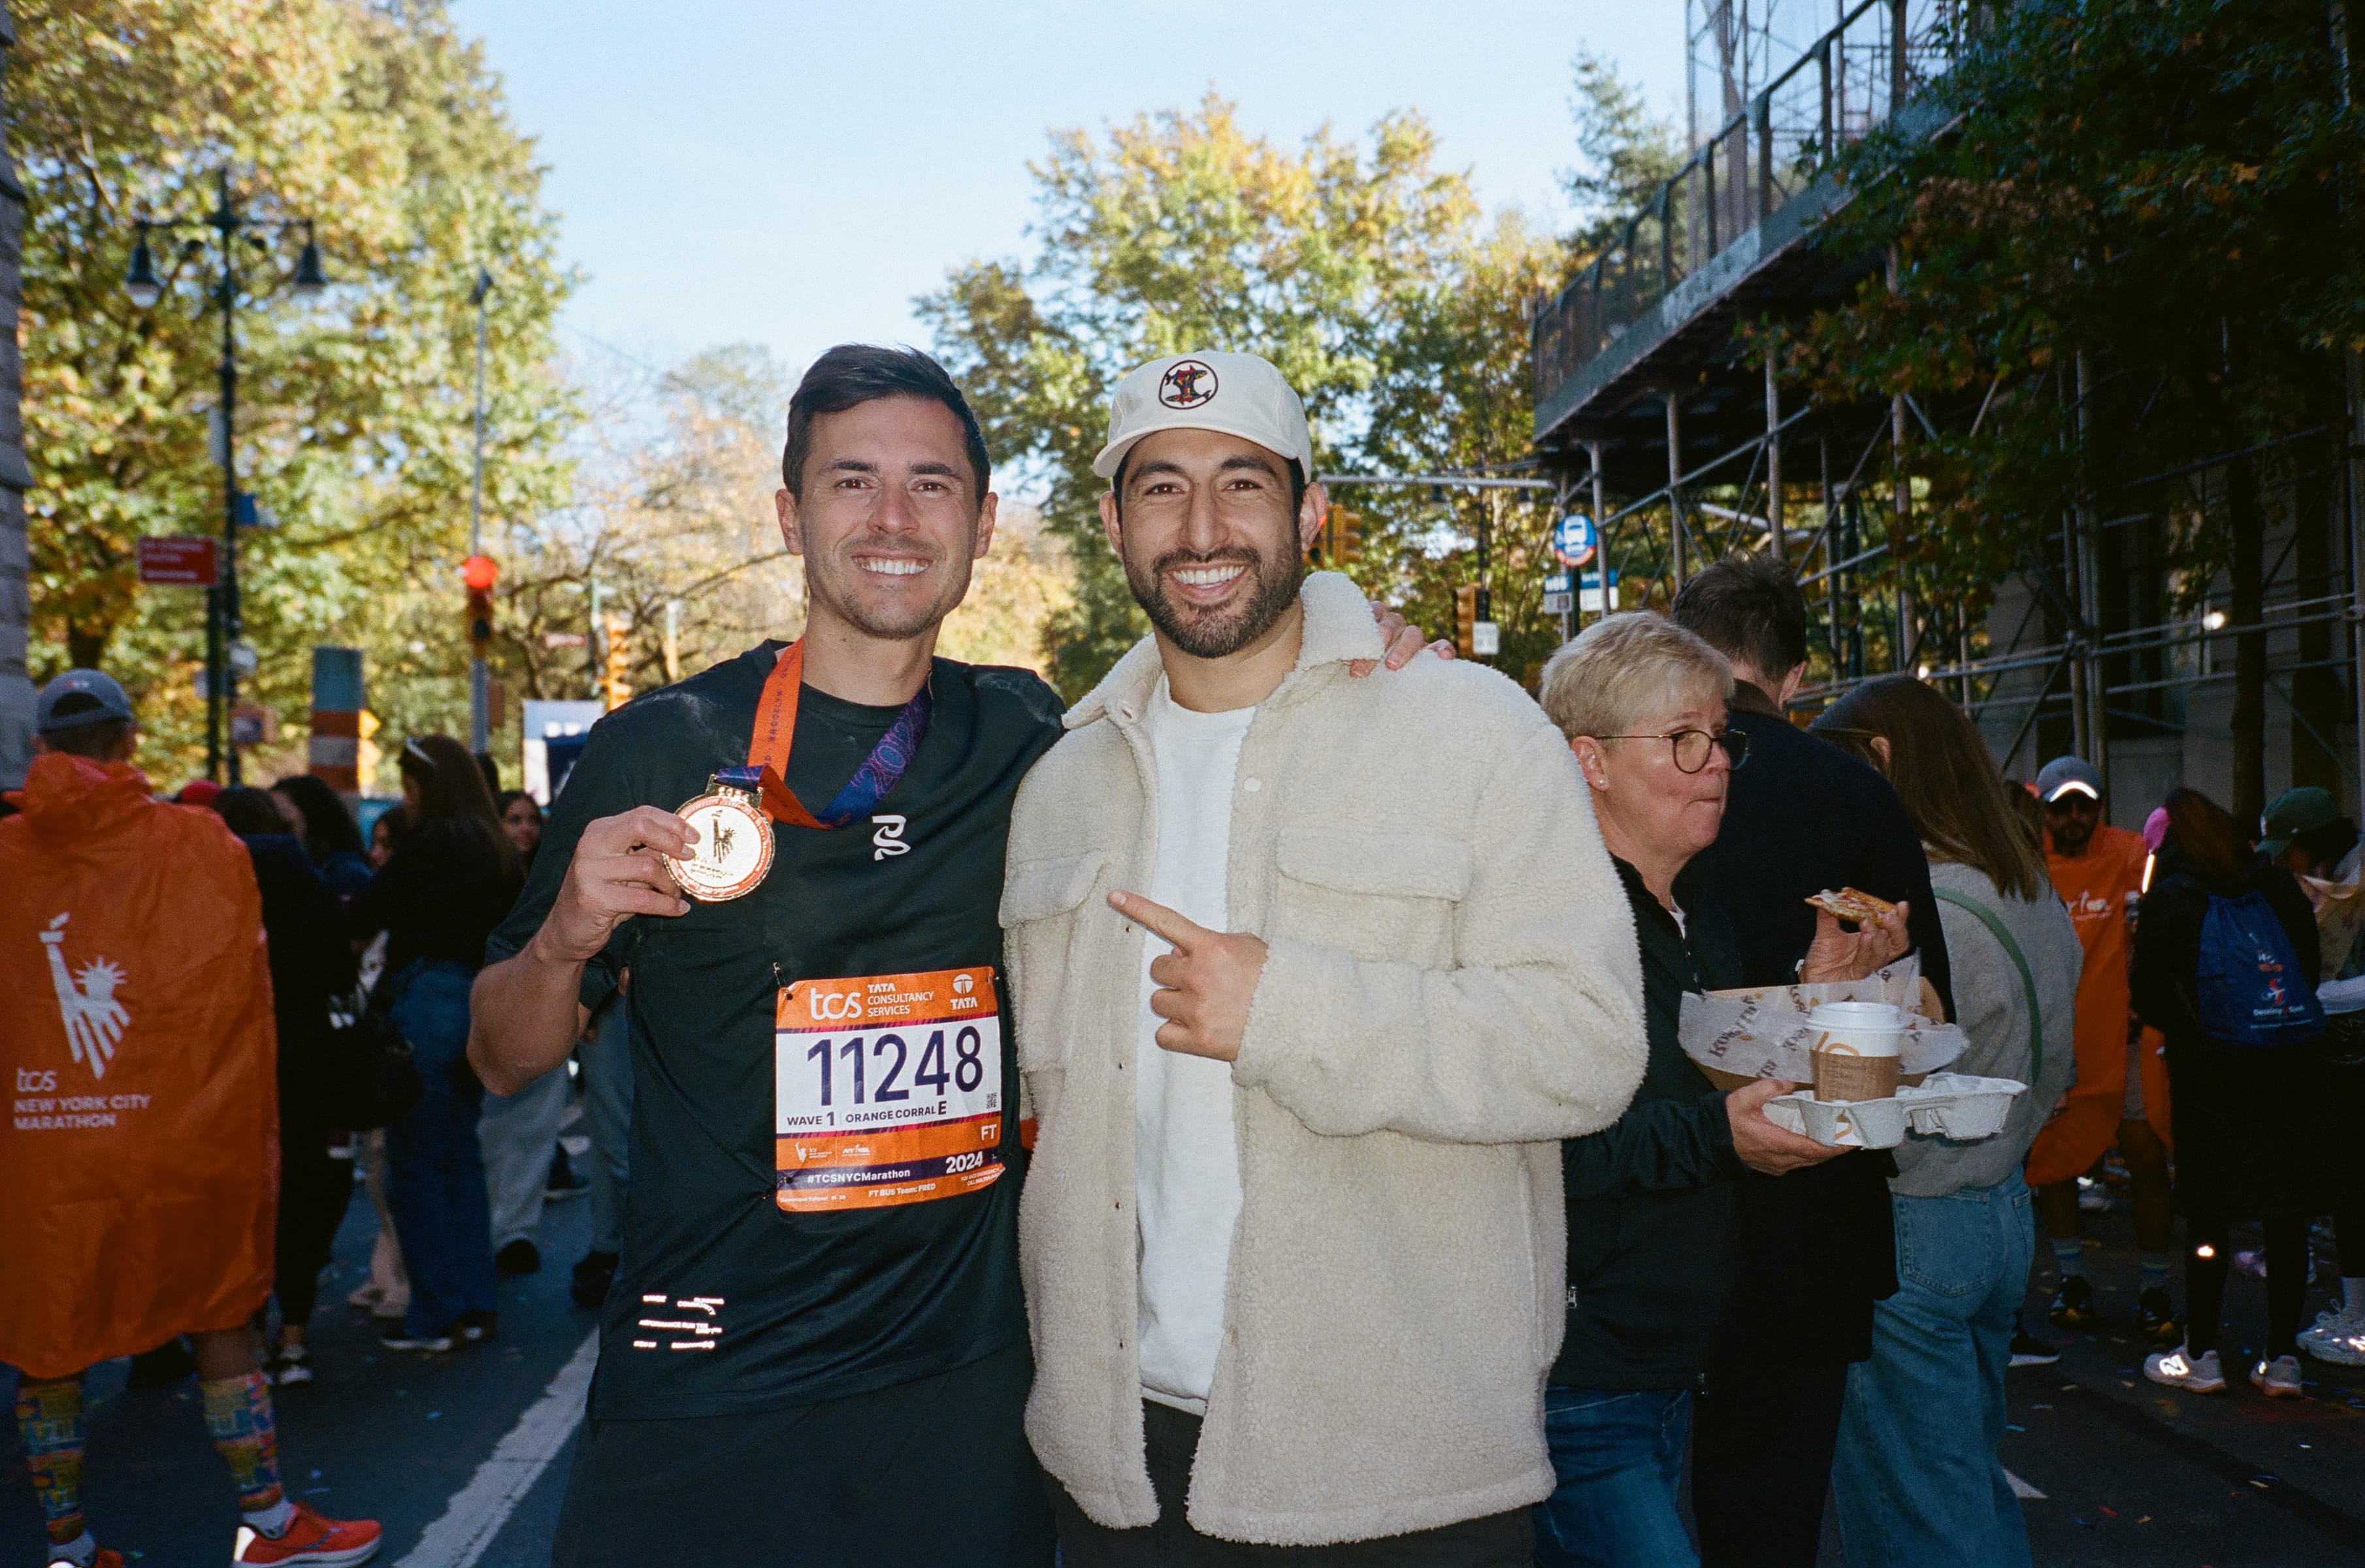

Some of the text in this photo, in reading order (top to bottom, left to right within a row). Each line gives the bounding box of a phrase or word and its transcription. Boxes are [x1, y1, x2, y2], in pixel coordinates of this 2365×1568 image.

[867, 983, 896, 993] TATA
[810, 987, 862, 1020] tcs
[867, 991, 934, 1005] CONSULTANCY
[950, 997, 978, 1010] TATA
[868, 1004, 911, 1018] SERVICES
[807, 1025, 983, 1107] 11248
[16, 1067, 58, 1093] tcs
[14, 1093, 152, 1113] NEW YORK CITY
[13, 1112, 116, 1130] MARATHON
[787, 1100, 947, 1126] WAVE 1 ORANGE CORRAL E
[981, 1123, 998, 1141] FT
[945, 1151, 984, 1174] 2024
[807, 1169, 911, 1184] #TCSNYCMarathon
